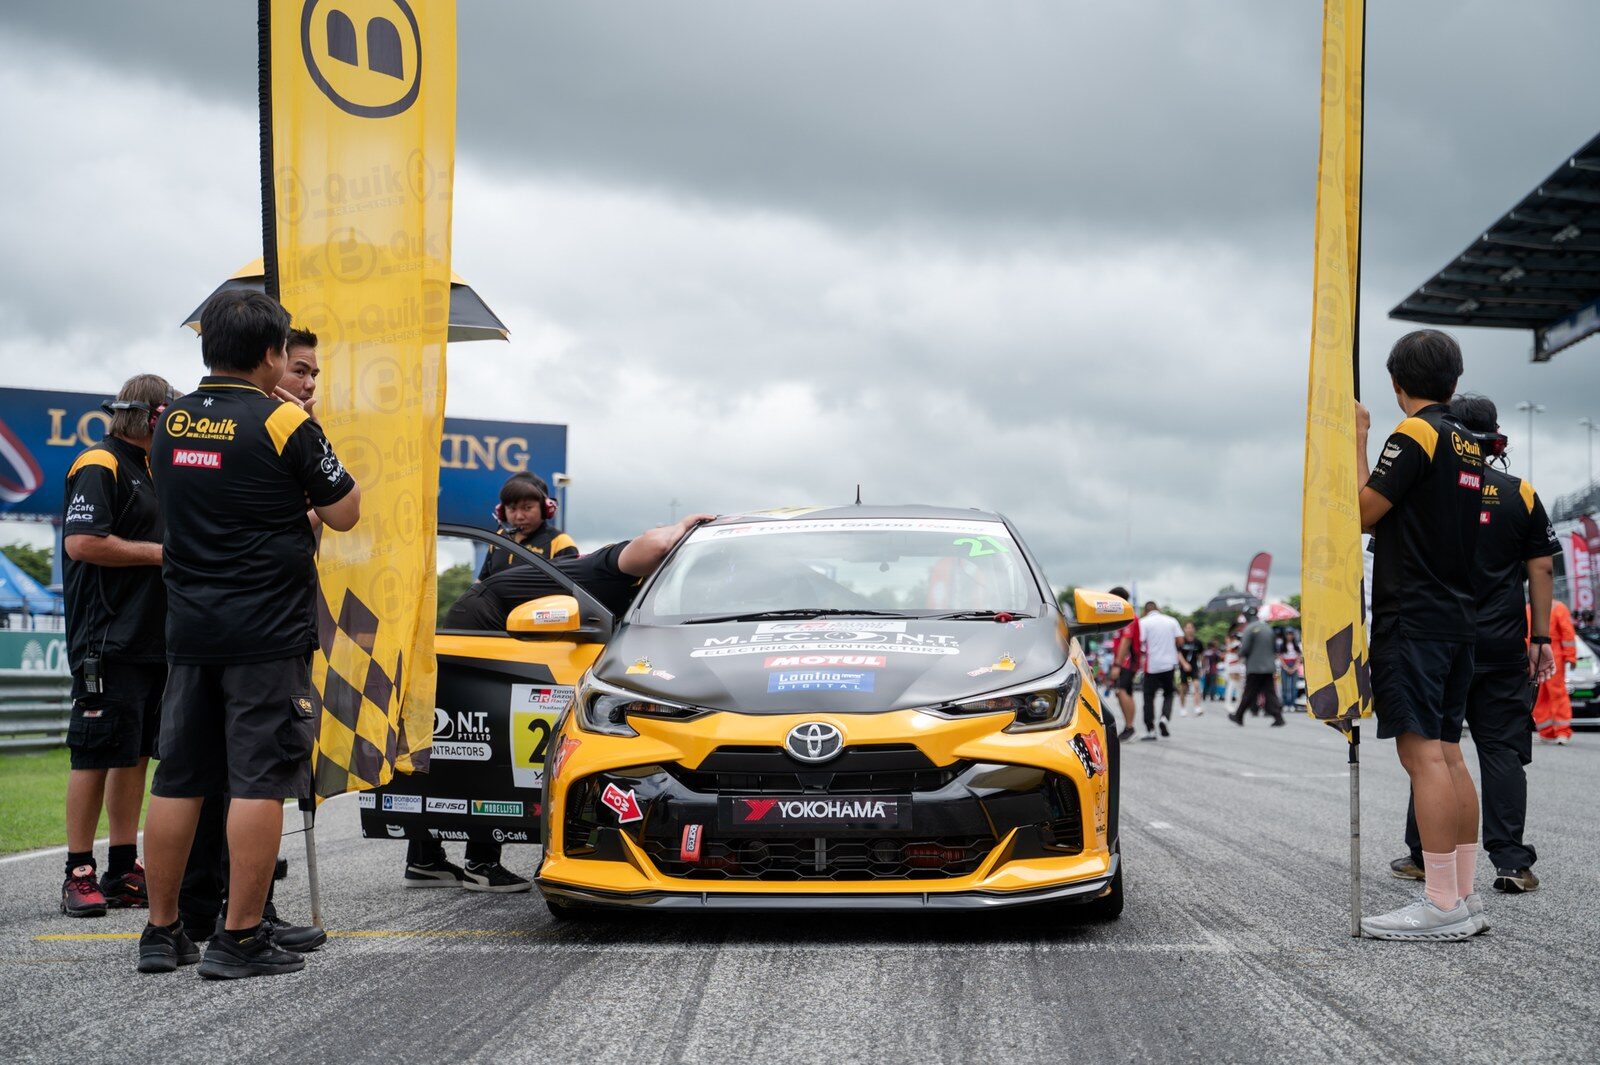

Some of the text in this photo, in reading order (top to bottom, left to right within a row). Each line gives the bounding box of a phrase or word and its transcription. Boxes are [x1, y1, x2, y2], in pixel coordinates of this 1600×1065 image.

[166, 409, 238, 438] B-Quik
[1451, 431, 1481, 456] B-Quik
[174, 451, 220, 467] MOTUL
[1459, 475, 1480, 489] MOTUL
[953, 535, 1009, 557] 21
[704, 642, 945, 656] ELECTRICAL CONTRACTORS
[770, 656, 881, 667] MOTUL
[780, 671, 841, 682] Lamina
[777, 683, 861, 691] DIGITAL
[427, 801, 466, 811] LENSO
[484, 803, 520, 814] MODELLISTA
[606, 791, 630, 813] TOW
[777, 801, 887, 819] YOKOHAMA
[439, 830, 470, 840] YUASA
